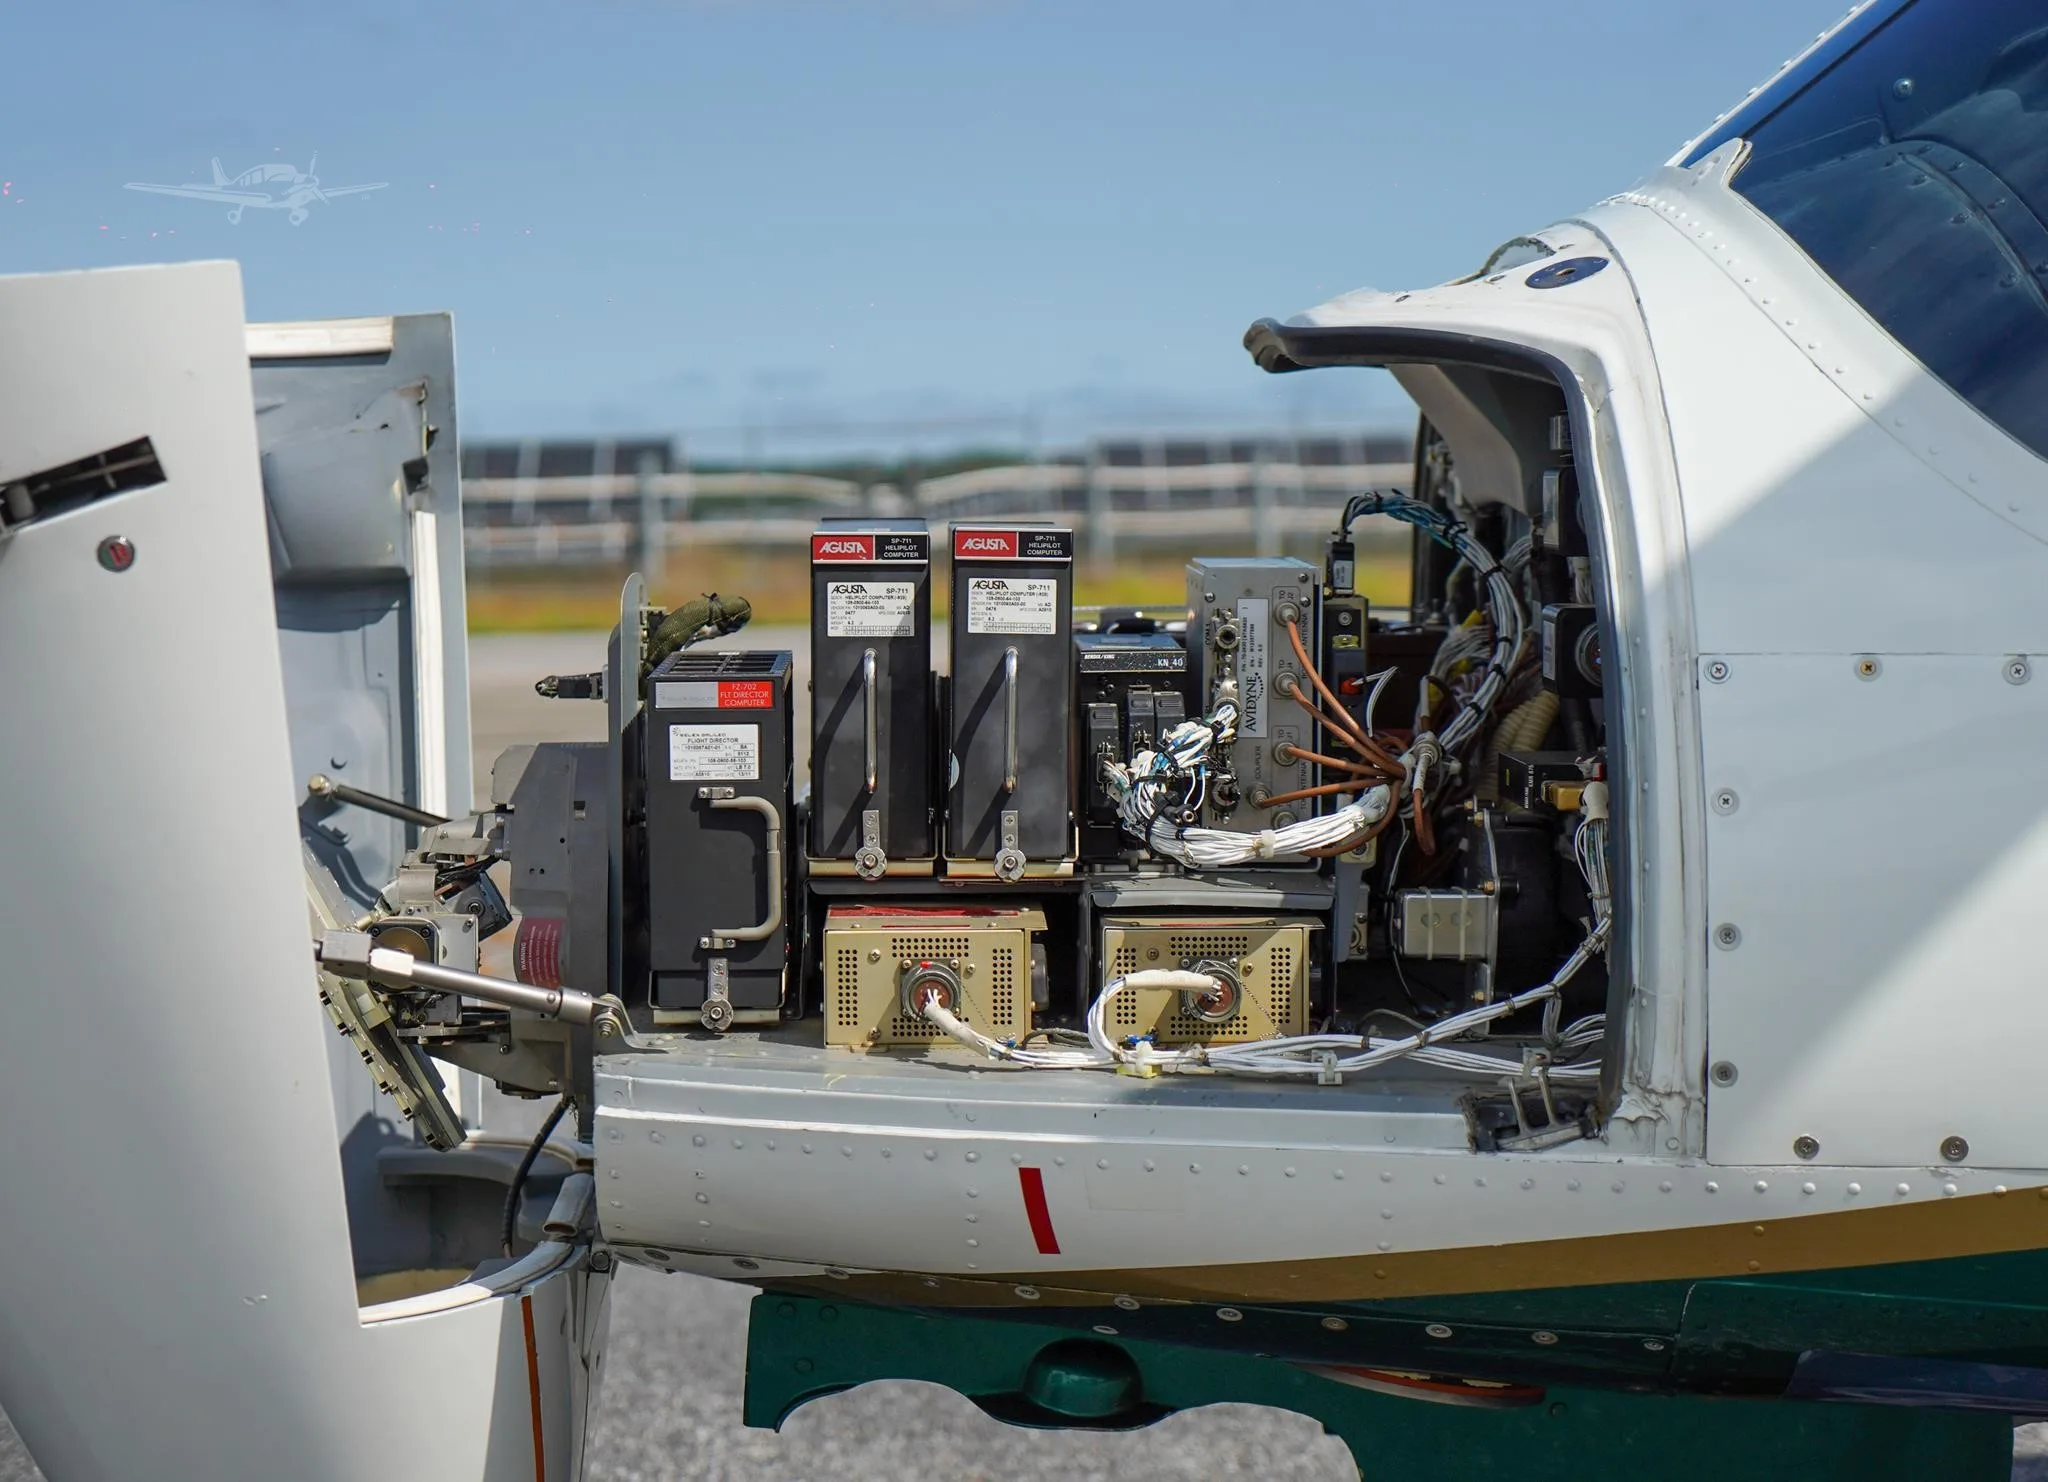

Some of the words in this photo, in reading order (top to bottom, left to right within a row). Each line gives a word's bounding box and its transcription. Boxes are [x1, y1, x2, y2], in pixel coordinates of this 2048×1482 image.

[820, 541, 867, 554] AGUSTA
[961, 538, 1010, 550] AGUSTA
[831, 584, 867, 594] AGUSTA
[972, 580, 1009, 590] AGUSTA
[1157, 658, 1169, 667] KN
[1172, 658, 1184, 667] 40
[724, 699, 765, 707] COMPUTER
[1244, 675, 1257, 732] AVIDYNE
